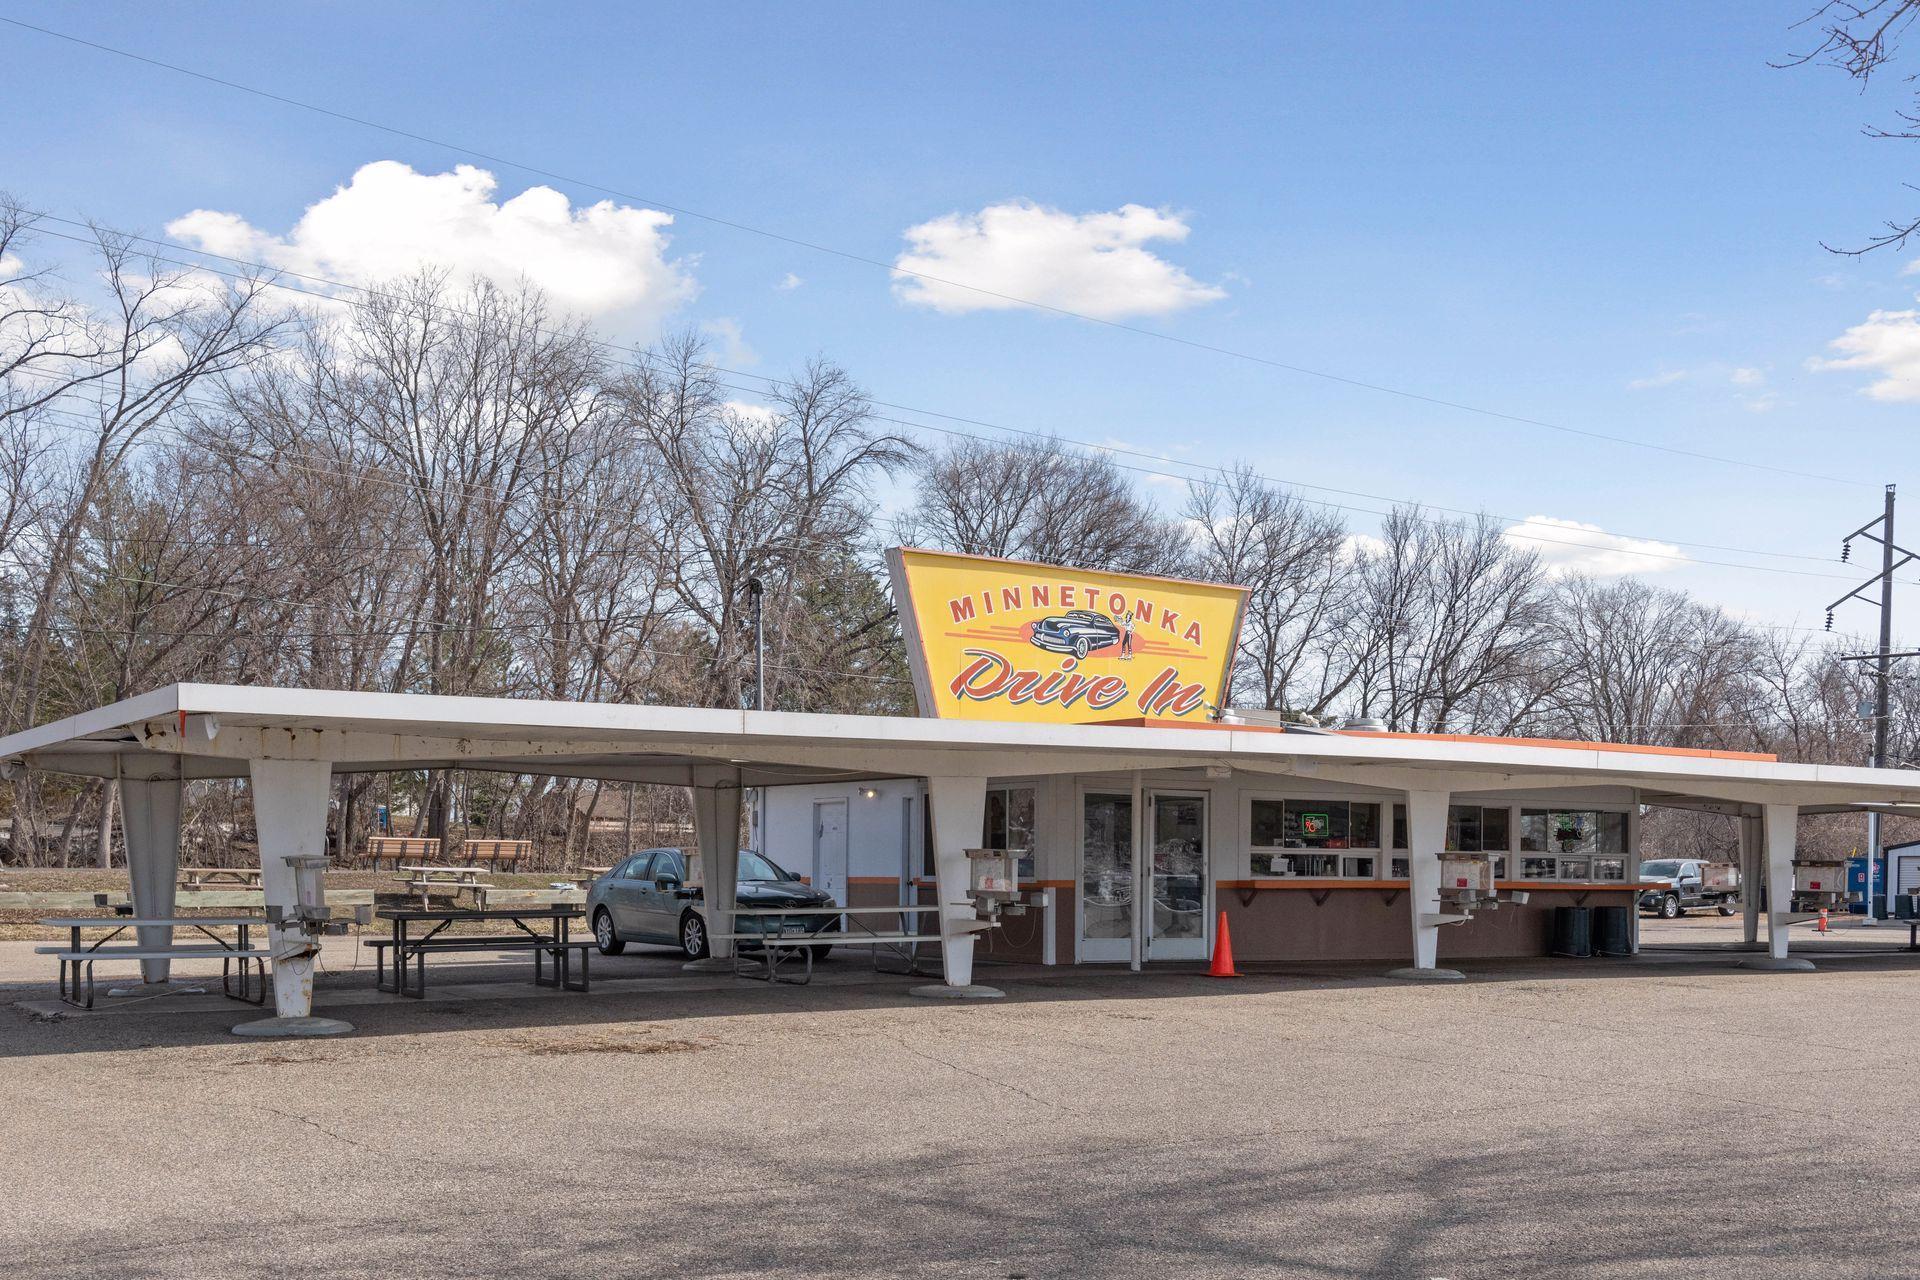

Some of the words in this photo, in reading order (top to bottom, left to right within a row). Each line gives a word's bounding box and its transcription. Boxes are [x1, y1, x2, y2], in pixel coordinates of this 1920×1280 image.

[949, 585, 1202, 648] MINNETONKA
[949, 648, 1129, 709] Drive
[1136, 666, 1206, 717] In
